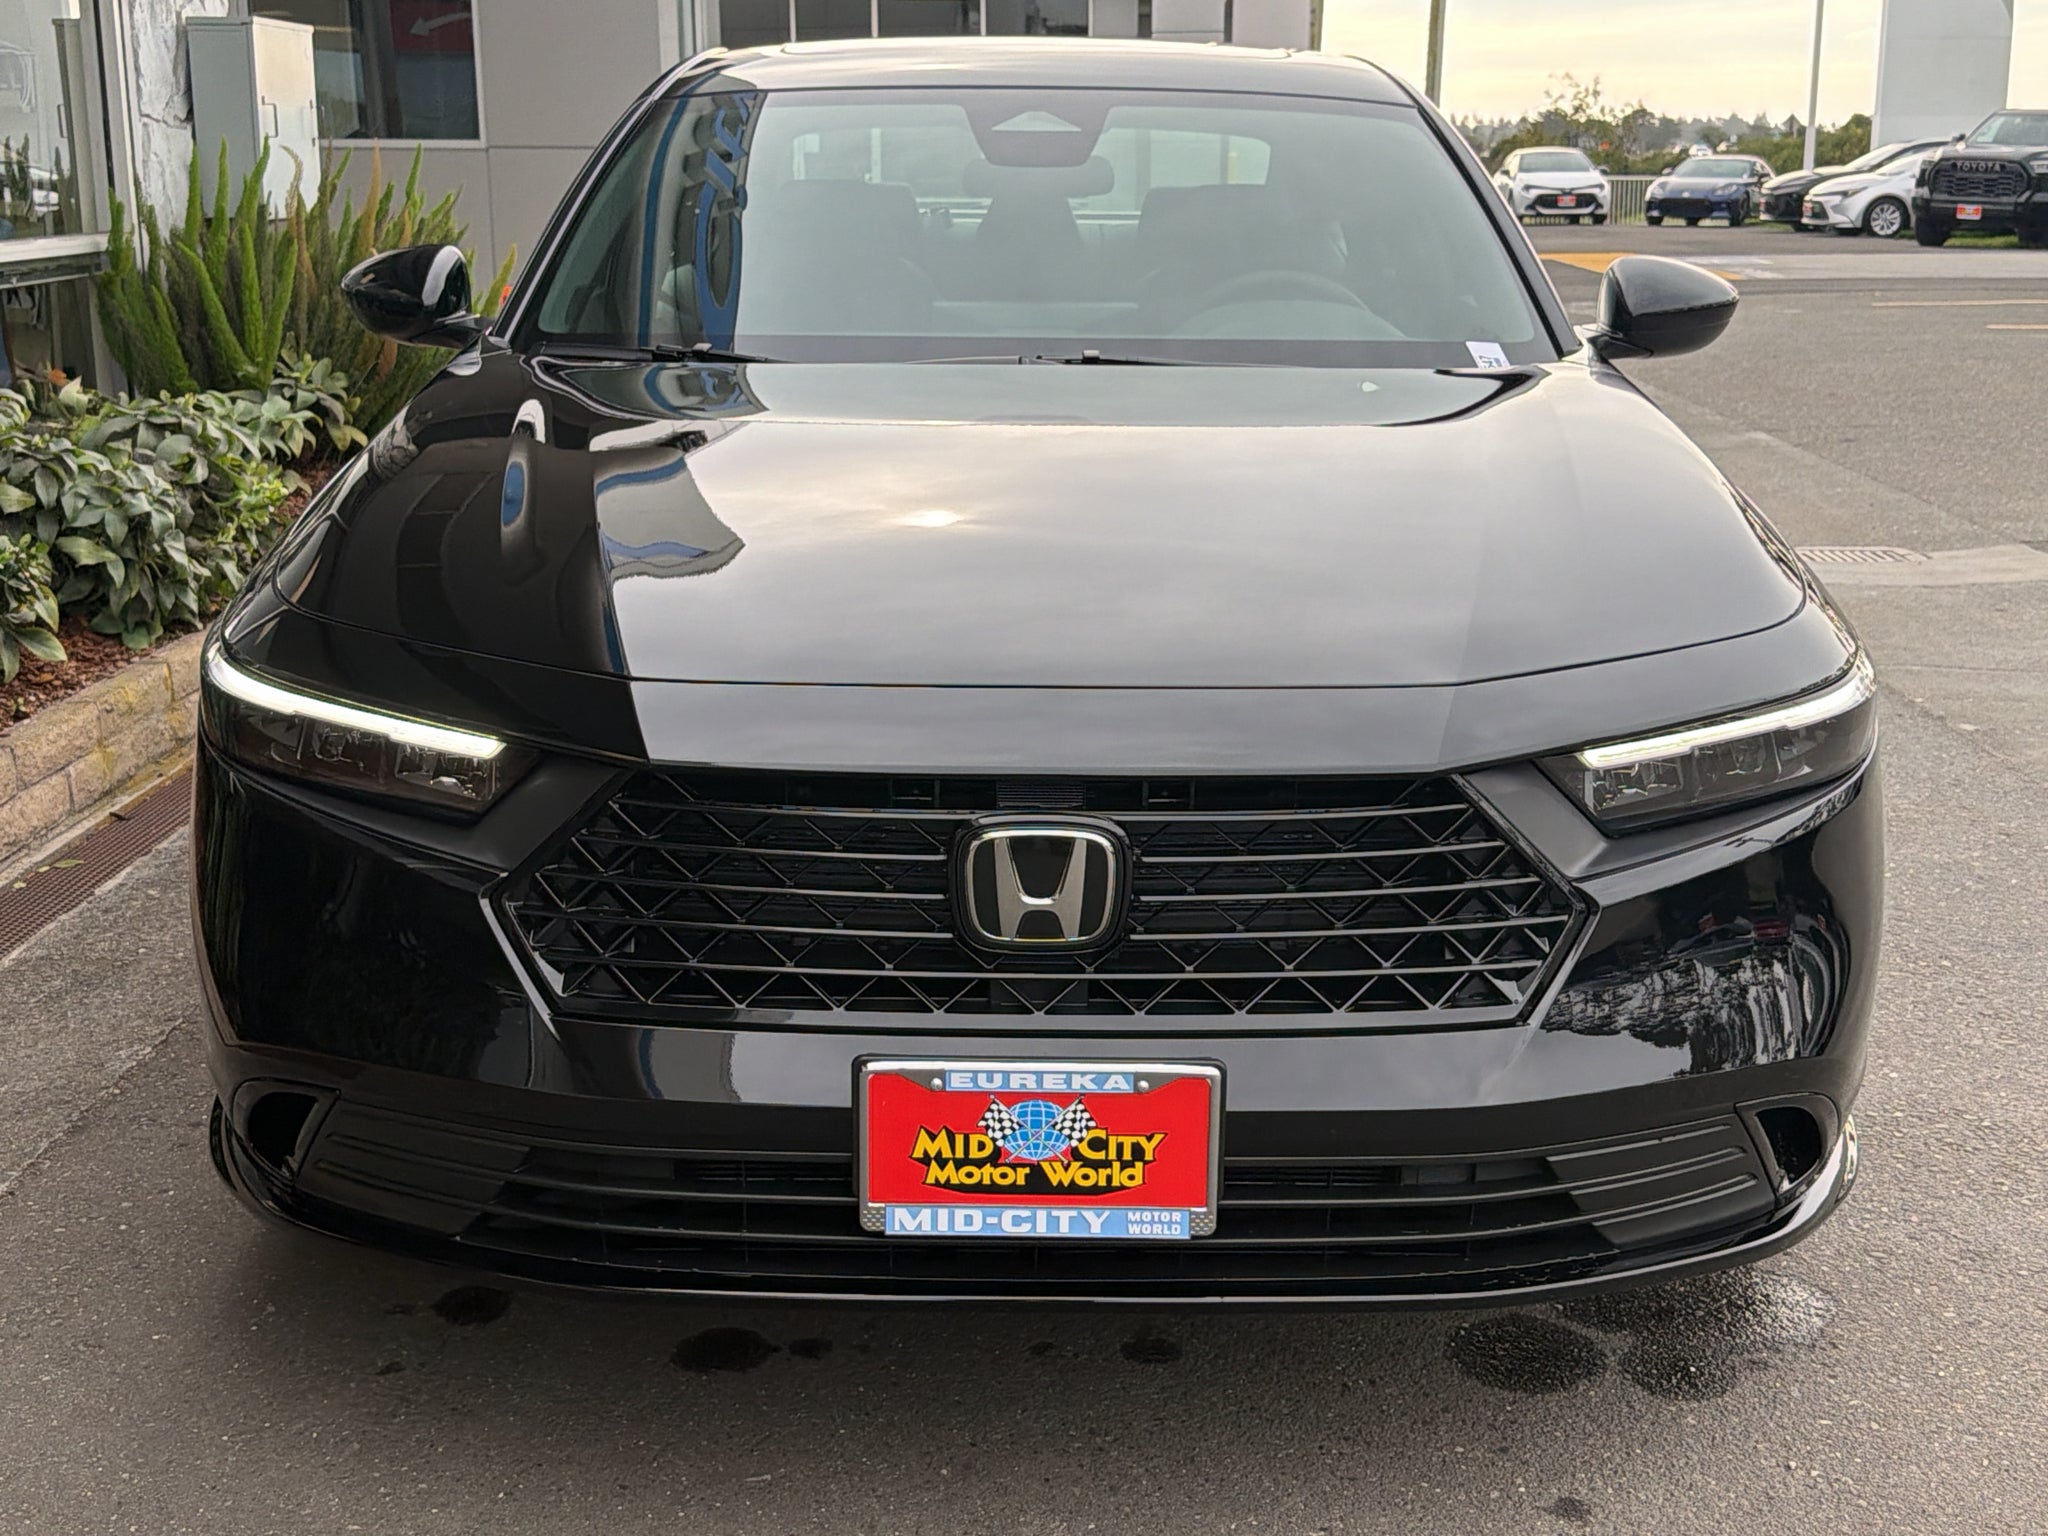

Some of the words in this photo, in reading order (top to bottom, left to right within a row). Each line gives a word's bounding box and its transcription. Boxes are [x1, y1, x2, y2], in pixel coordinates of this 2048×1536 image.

[1955, 160, 2000, 172] TOYOTA
[950, 1072, 1130, 1089] EUREKA
[913, 1128, 992, 1158] MID
[1078, 1128, 1164, 1160] CITY
[925, 1161, 1030, 1185] Motor
[1039, 1161, 1144, 1187] World
[893, 1208, 1110, 1233] MID-CITY
[1127, 1211, 1181, 1222] MOTOR
[1128, 1223, 1181, 1235] WORLD
